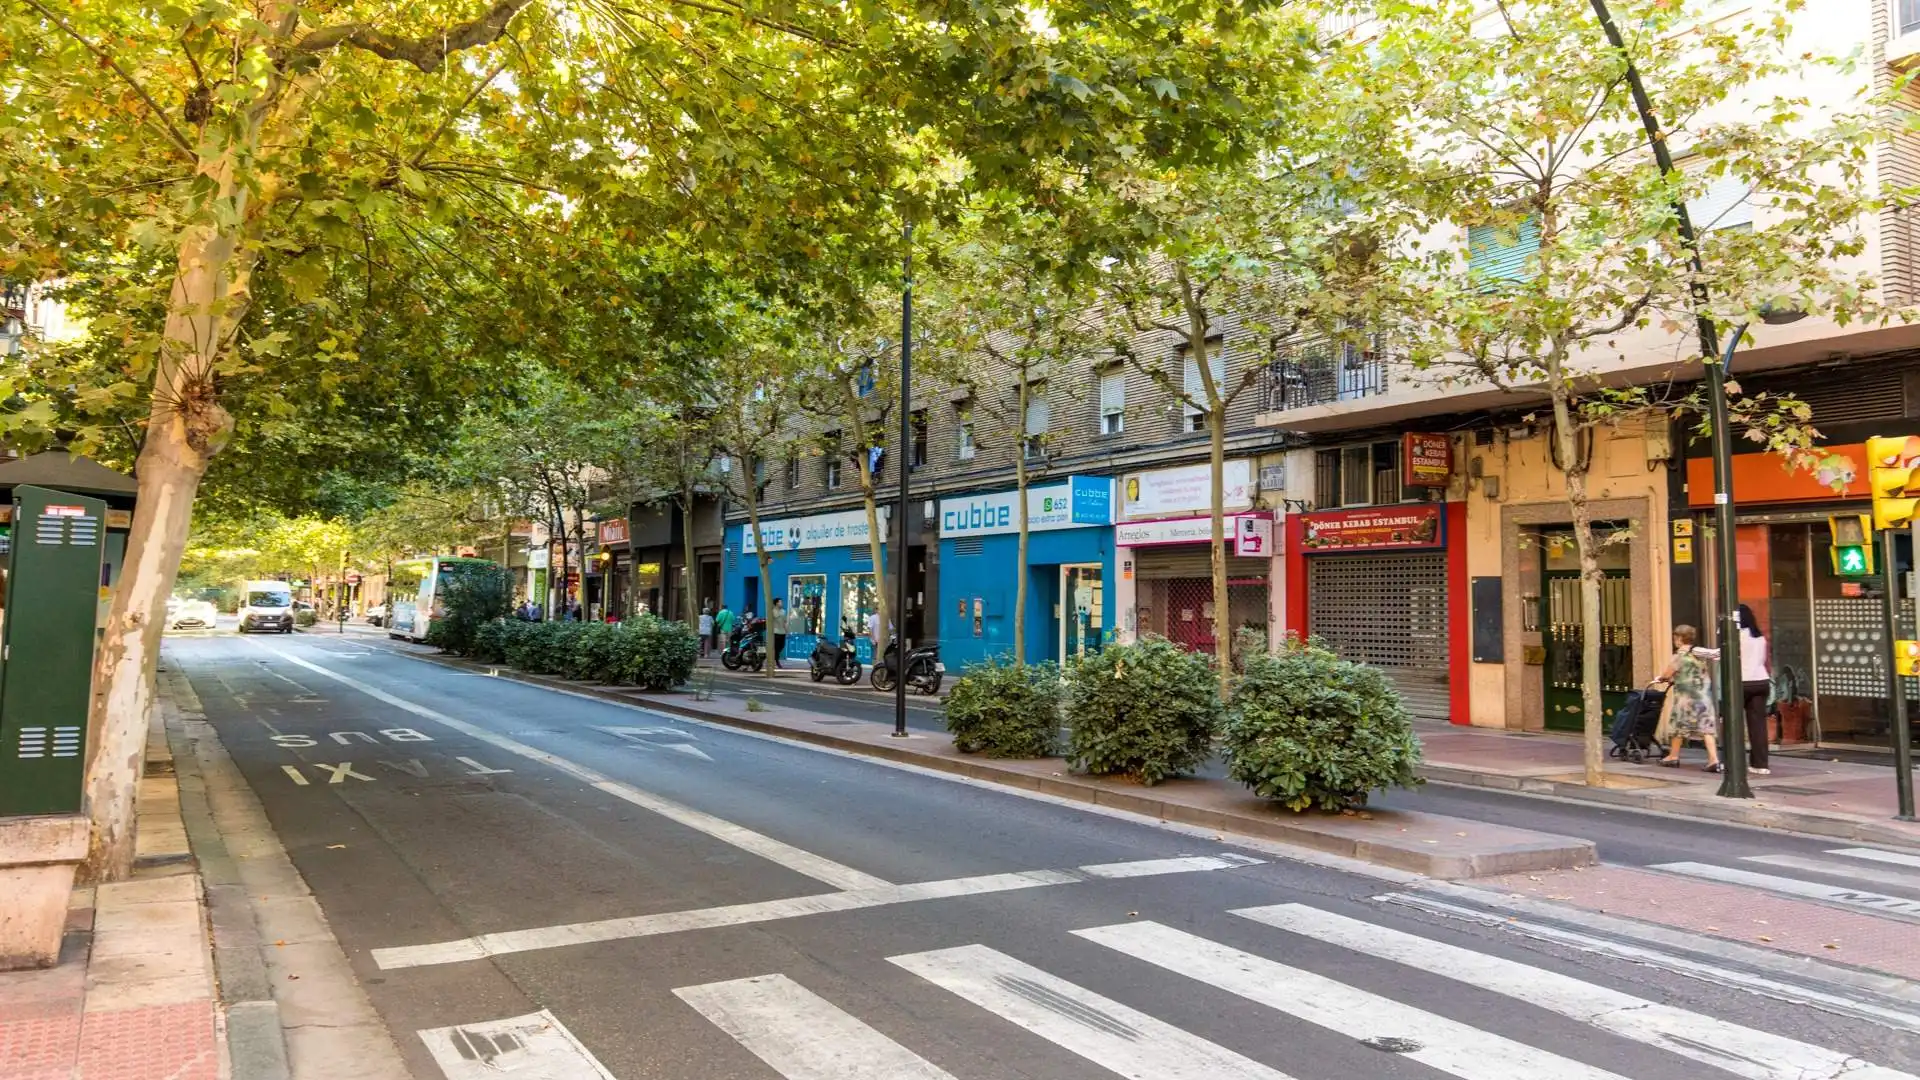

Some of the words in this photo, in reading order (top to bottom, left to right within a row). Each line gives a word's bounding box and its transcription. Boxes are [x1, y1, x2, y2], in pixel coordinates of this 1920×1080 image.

[1412, 456, 1447, 467] ESTAMBUL
[1426, 449, 1447, 458] KEBAB
[944, 501, 1010, 531] cubbe
[1342, 518, 1371, 528] KEBAB
[1372, 515, 1419, 526] ESTAMBUL
[835, 521, 846, 537] de
[270, 728, 435, 748] BUS
[281, 756, 514, 785] TAXI
